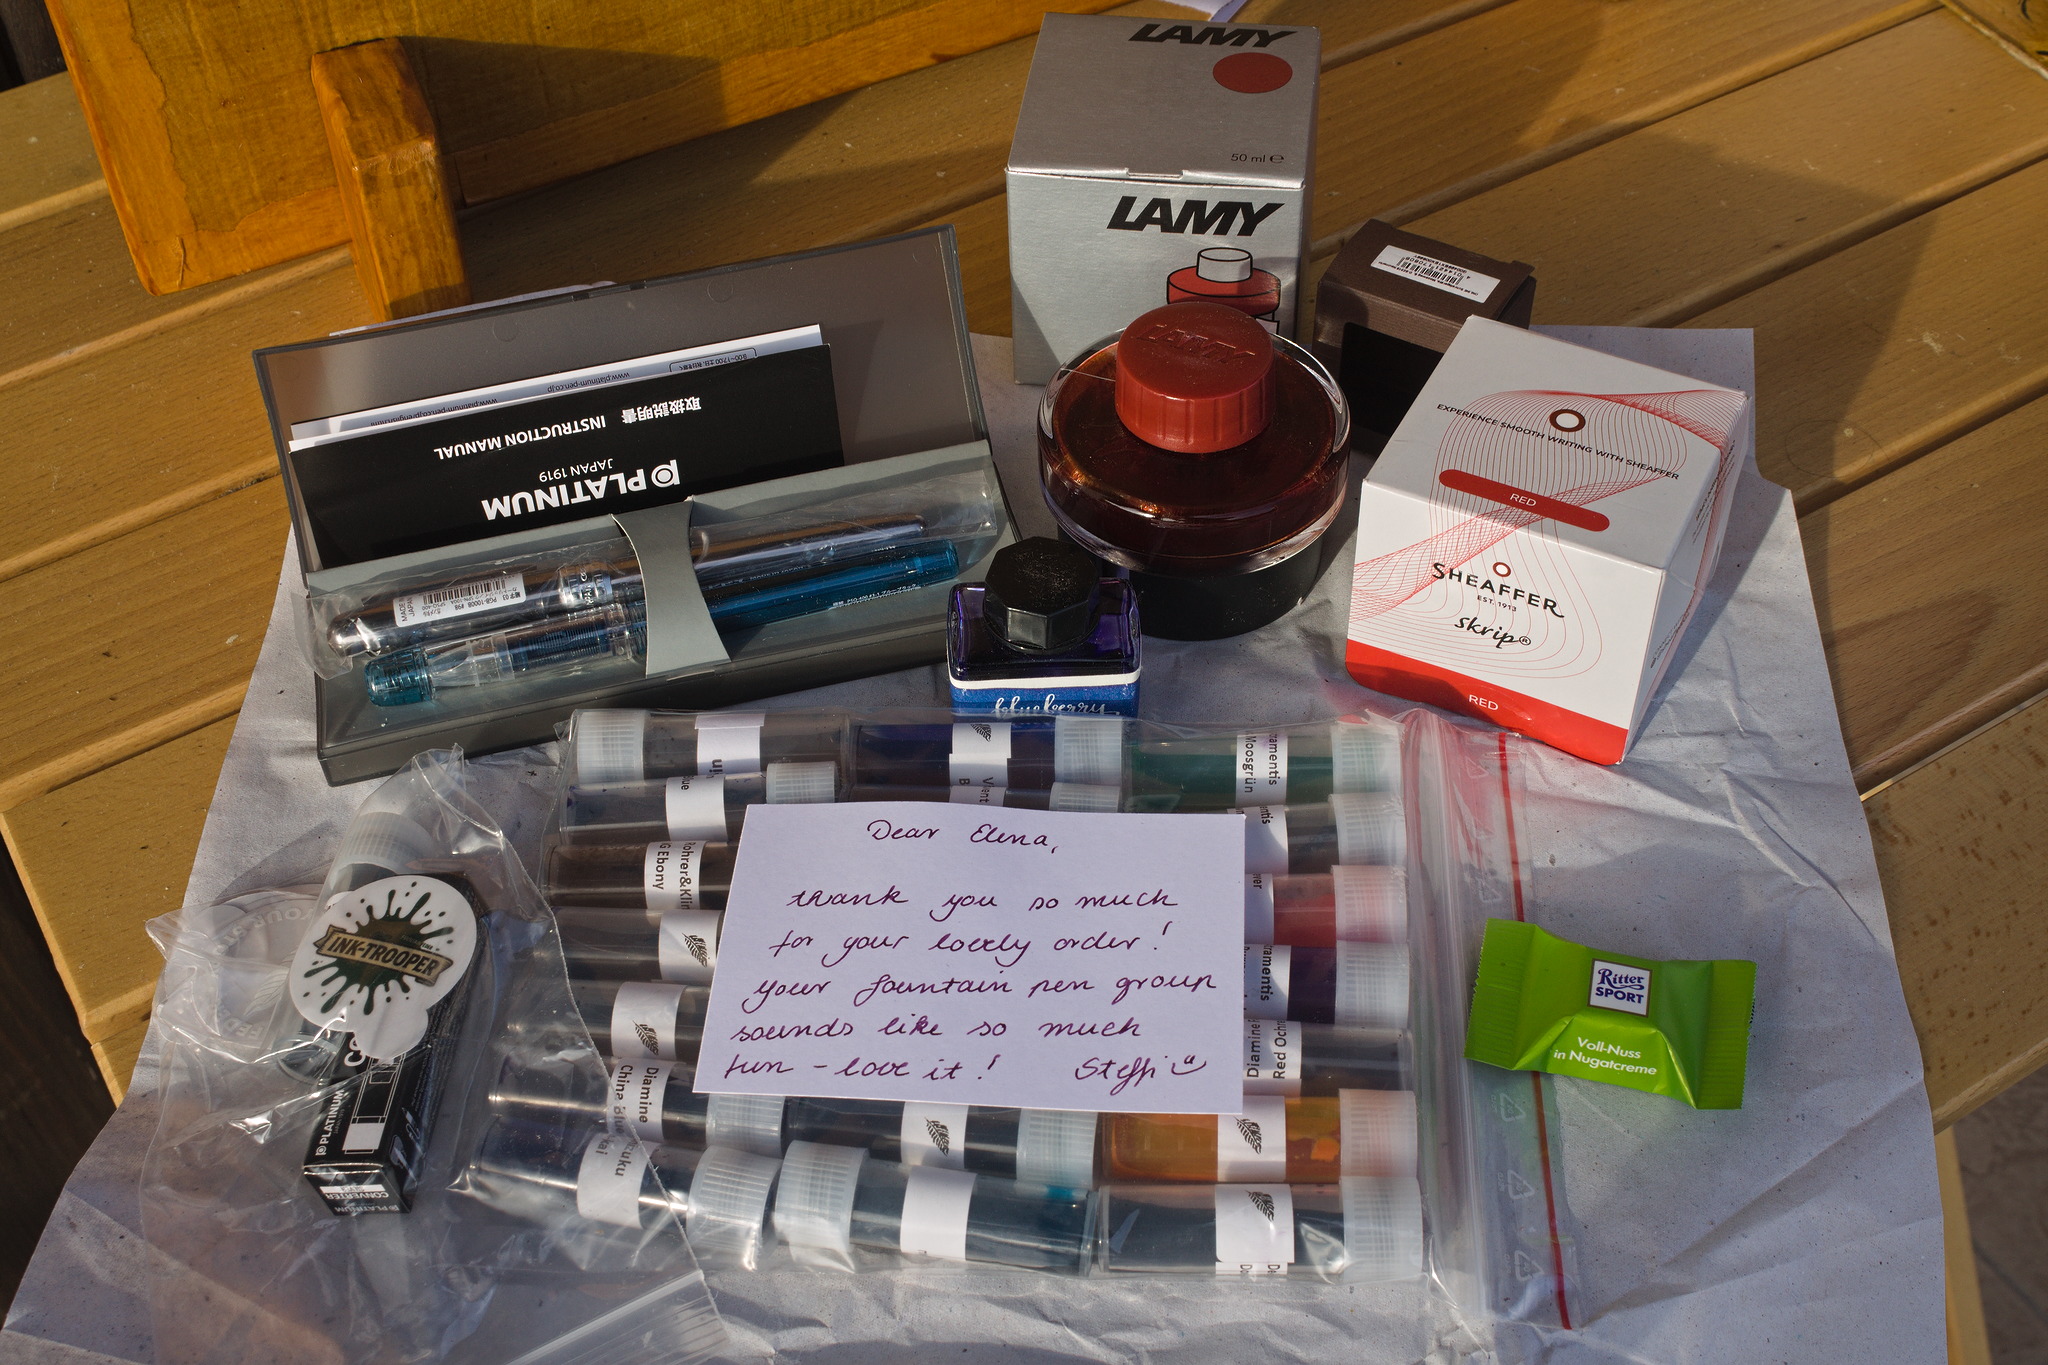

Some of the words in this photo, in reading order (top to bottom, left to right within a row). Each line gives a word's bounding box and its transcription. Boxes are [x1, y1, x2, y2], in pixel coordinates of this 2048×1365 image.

[1129, 24, 1297, 48] LAMY
[1231, 153, 1247, 163] 50
[1251, 153, 1266, 163] ml
[1106, 196, 1285, 237] LAMY
[621, 396, 702, 424] 取扱説明書
[505, 415, 606, 447] INSTRUCTION
[1437, 404, 1498, 426] EXPERIENCE
[1500, 422, 1545, 439] SMOOTH
[1548, 435, 1592, 454] WRITING
[1595, 446, 1624, 464] WITH
[1626, 457, 1680, 480] SHEAFFER
[434, 436, 501, 460] MANUAL
[538, 467, 568, 483] 1919
[570, 458, 614, 477] JAPAN
[482, 468, 646, 521] PLATINUM
[1510, 493, 1537, 507] RED
[1432, 562, 1565, 618] SHEAFFER
[1477, 594, 1494, 605] EST.
[1496, 600, 1517, 612] 1913
[1468, 694, 1498, 710] RED
[1242, 736, 1257, 793] Moosgrün
[867, 819, 939, 840] Dear
[653, 851, 669, 890] Ebony
[786, 886, 908, 908] thank
[929, 893, 996, 921] you
[1030, 896, 1057, 911] so
[1075, 890, 1178, 908] much
[328, 935, 439, 978] INK-TROOPER
[768, 931, 814, 955] for
[822, 935, 908, 967] your
[928, 936, 1031, 967] lovely
[743, 979, 830, 1012] your
[854, 970, 1013, 1006] fountain
[1028, 979, 1095, 997] pen
[1110, 974, 1217, 1004] group
[1597, 968, 1646, 991] Ritter
[1595, 987, 1644, 1004] SPORT
[731, 1019, 854, 1041] sounds
[878, 1012, 943, 1035] like
[968, 1021, 1006, 1037] so
[1038, 1020, 1141, 1037] much
[1554, 1047, 1566, 1060] in
[1568, 1050, 1657, 1076] Nugatcreme
[1577, 1036, 1641, 1059] Voll-Nuss
[724, 1054, 793, 1078] fun
[834, 1057, 909, 1077] love
[1273, 1052, 1286, 1079] Red
[638, 1066, 659, 1124] Diamine
[319, 1090, 345, 1144] PLATINUM
